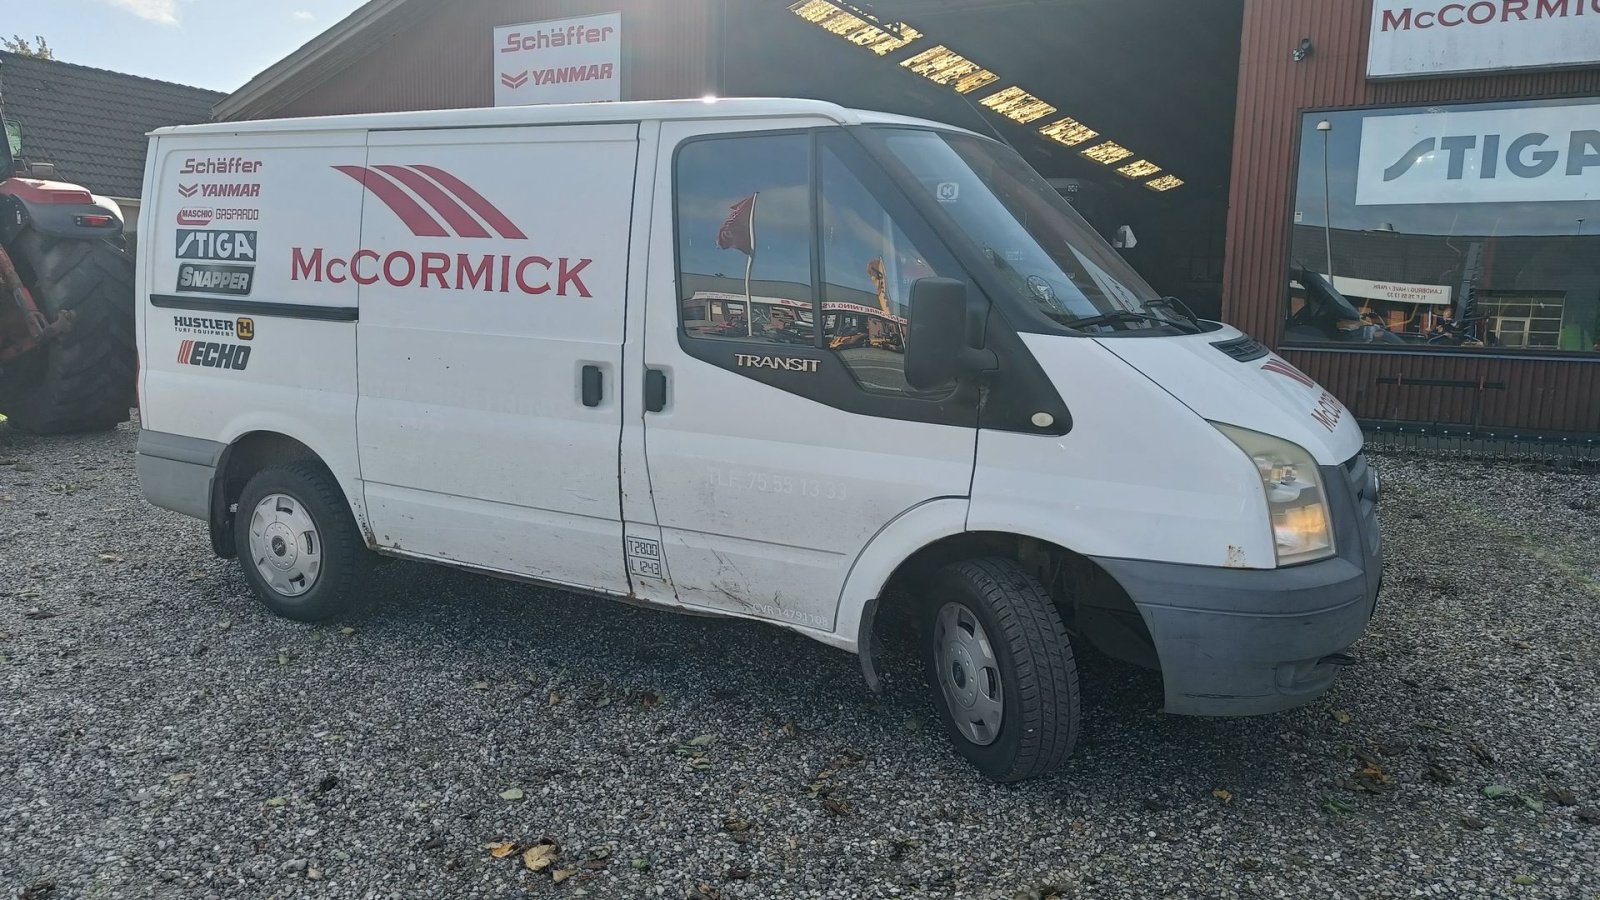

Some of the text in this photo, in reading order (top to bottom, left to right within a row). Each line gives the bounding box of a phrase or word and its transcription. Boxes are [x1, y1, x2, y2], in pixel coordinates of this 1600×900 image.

[501, 25, 613, 53] Schäffer
[532, 63, 613, 85] YANMAR
[180, 157, 262, 174] Schäffer
[1383, 130, 1600, 182] STIGA
[201, 184, 261, 197] YANMAR
[182, 208, 259, 220] MASCHIO GASPARDO
[178, 232, 254, 259] STIGA
[180, 266, 250, 290] SNAPPER
[291, 248, 593, 297] McCORMICK
[174, 316, 234, 331] HUSTLER
[194, 329, 234, 337] EQUIPMENT
[189, 341, 252, 371] ECHO
[735, 353, 821, 372] TRANSIT
